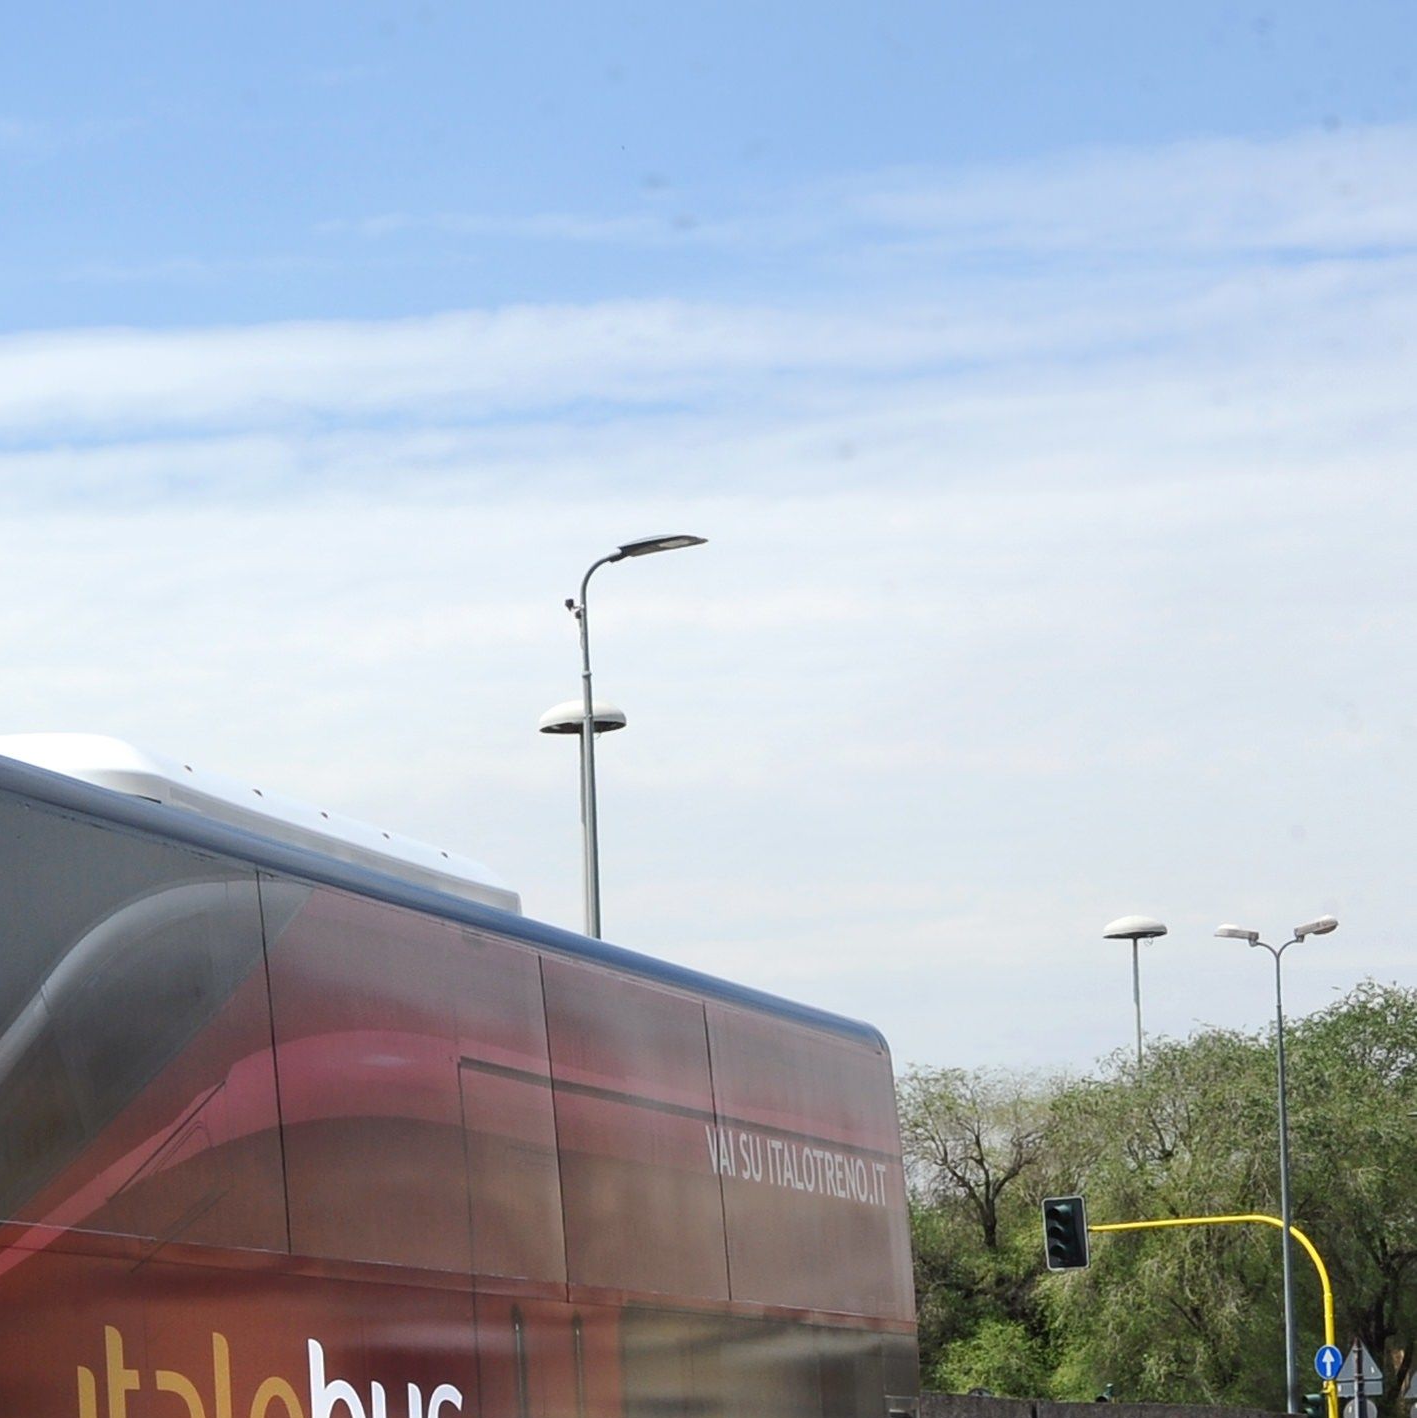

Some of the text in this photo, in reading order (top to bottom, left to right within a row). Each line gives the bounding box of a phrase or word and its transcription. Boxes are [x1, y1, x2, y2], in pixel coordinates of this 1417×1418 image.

[704, 1125, 887, 1206] VAI SU ITALOTRENO.IT
